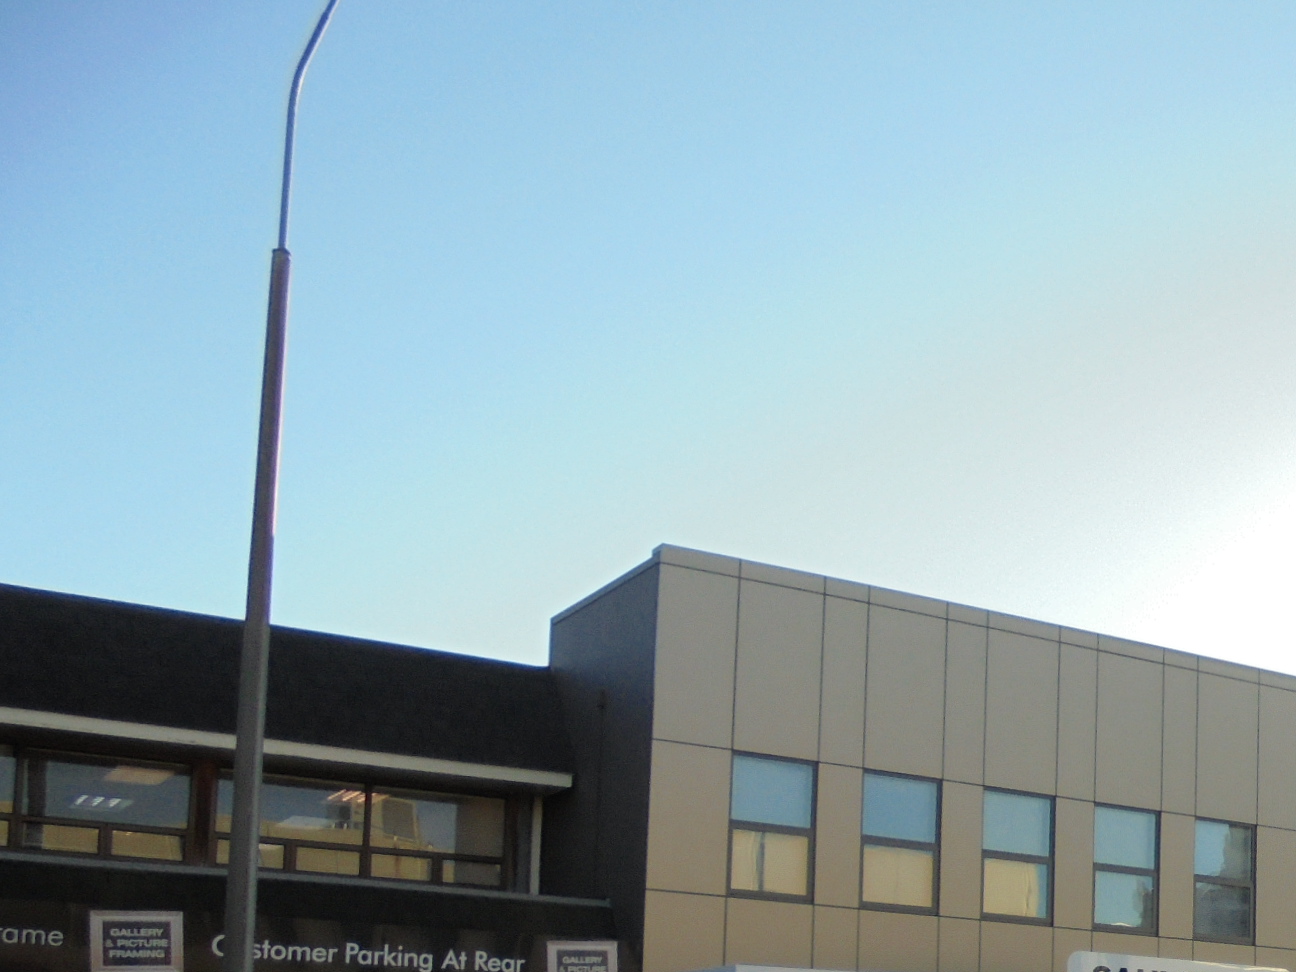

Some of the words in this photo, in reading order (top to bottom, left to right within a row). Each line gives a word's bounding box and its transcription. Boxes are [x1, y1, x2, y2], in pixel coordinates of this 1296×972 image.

[110, 927, 163, 937] GALLERY
[117, 938, 169, 949] PICTURE
[108, 949, 165, 959] FRAMING
[211, 934, 338, 964] Cstomer
[346, 942, 434, 972] Parking
[441, 948, 468, 971] At
[562, 955, 603, 965] GALLERY
